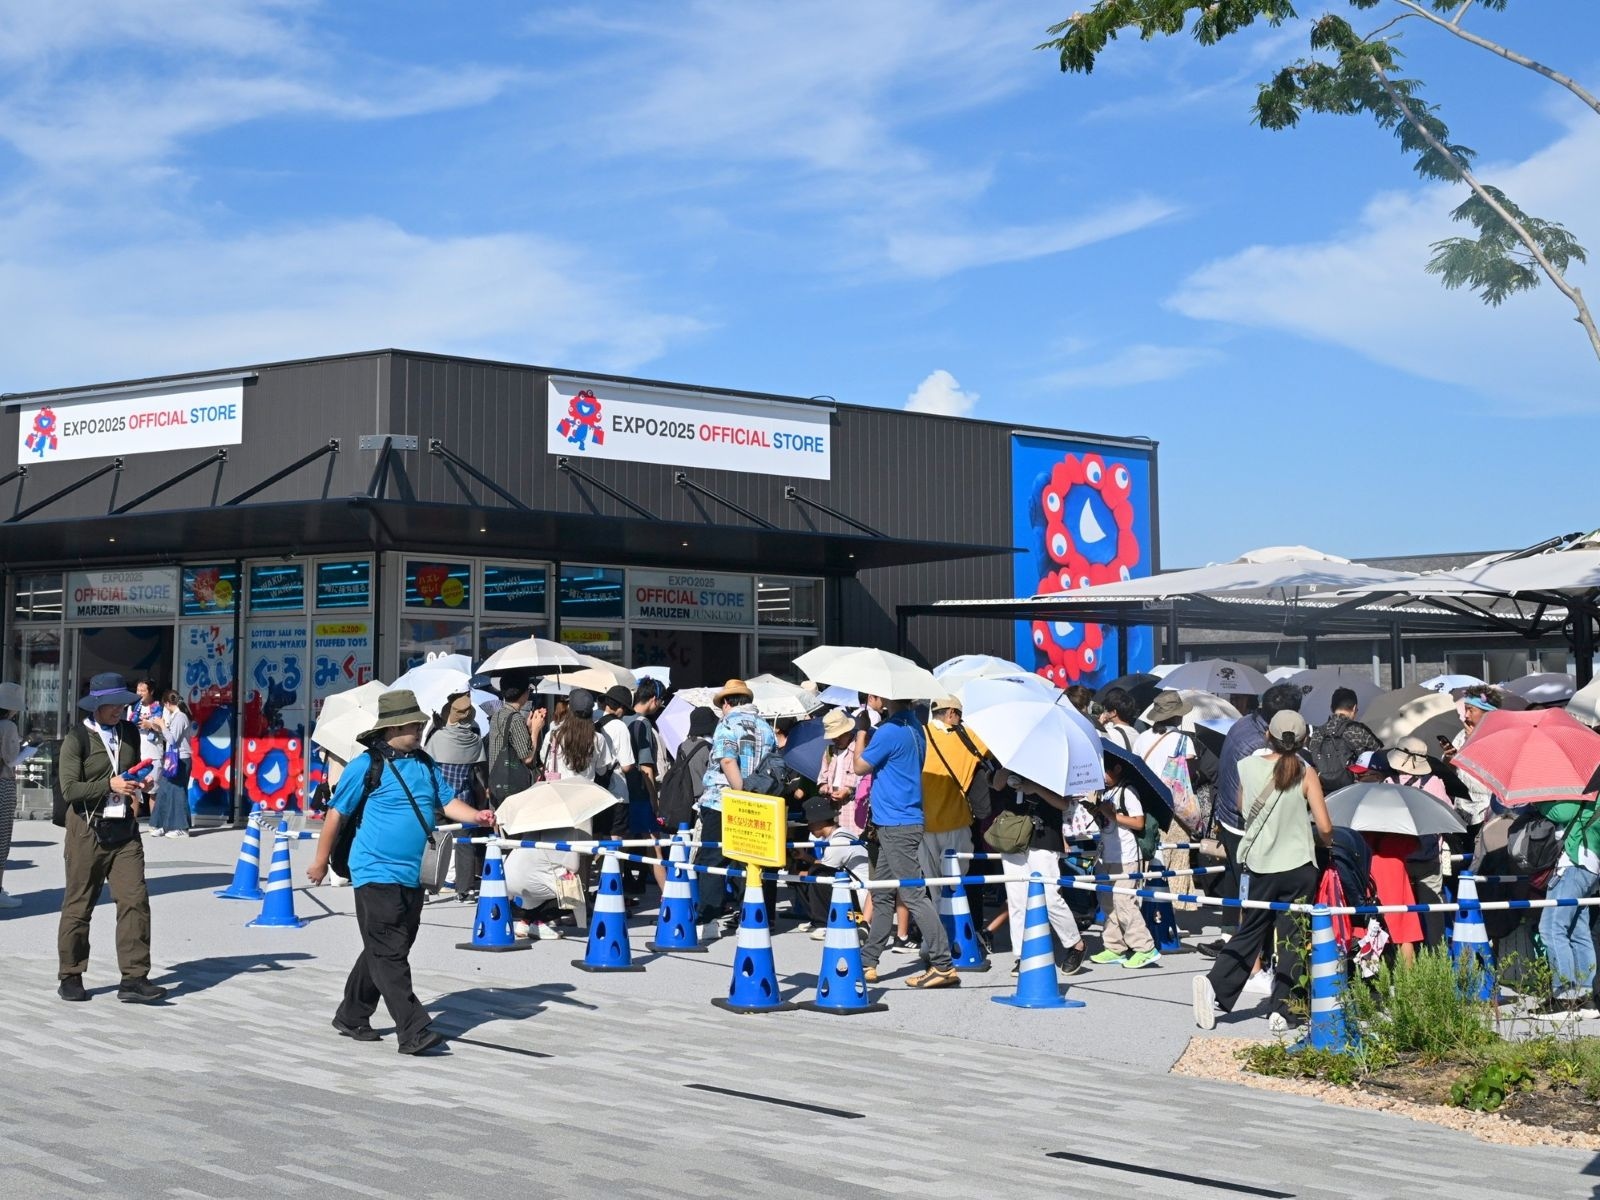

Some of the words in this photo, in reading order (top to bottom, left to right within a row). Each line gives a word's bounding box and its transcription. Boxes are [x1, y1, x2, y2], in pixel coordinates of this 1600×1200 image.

[63, 416, 126, 437] EXPO2025
[128, 409, 187, 431] OFFICIAL
[190, 404, 237, 424] STORE
[612, 415, 696, 440] EXPO2025
[699, 424, 771, 448] OFFICIAL
[773, 432, 825, 453] STORE
[102, 572, 144, 583] EXPO2025
[668, 575, 715, 588] EXPO2025
[74, 587, 128, 602] OFFICIAL
[128, 584, 170, 600] STORE
[636, 587, 698, 605] OFFICIAL
[699, 591, 745, 607] STORE
[77, 605, 120, 616] MARUZEN
[640, 606, 690, 619] MARUZEN
[691, 608, 742, 621] JUNKUDO
[251, 629, 276, 637] LOTTERY
[278, 629, 292, 637] SALE
[251, 639, 307, 649] MYAKU-MYAKU
[315, 638, 346, 648] STUFFED
[347, 637, 368, 647] TOYS
